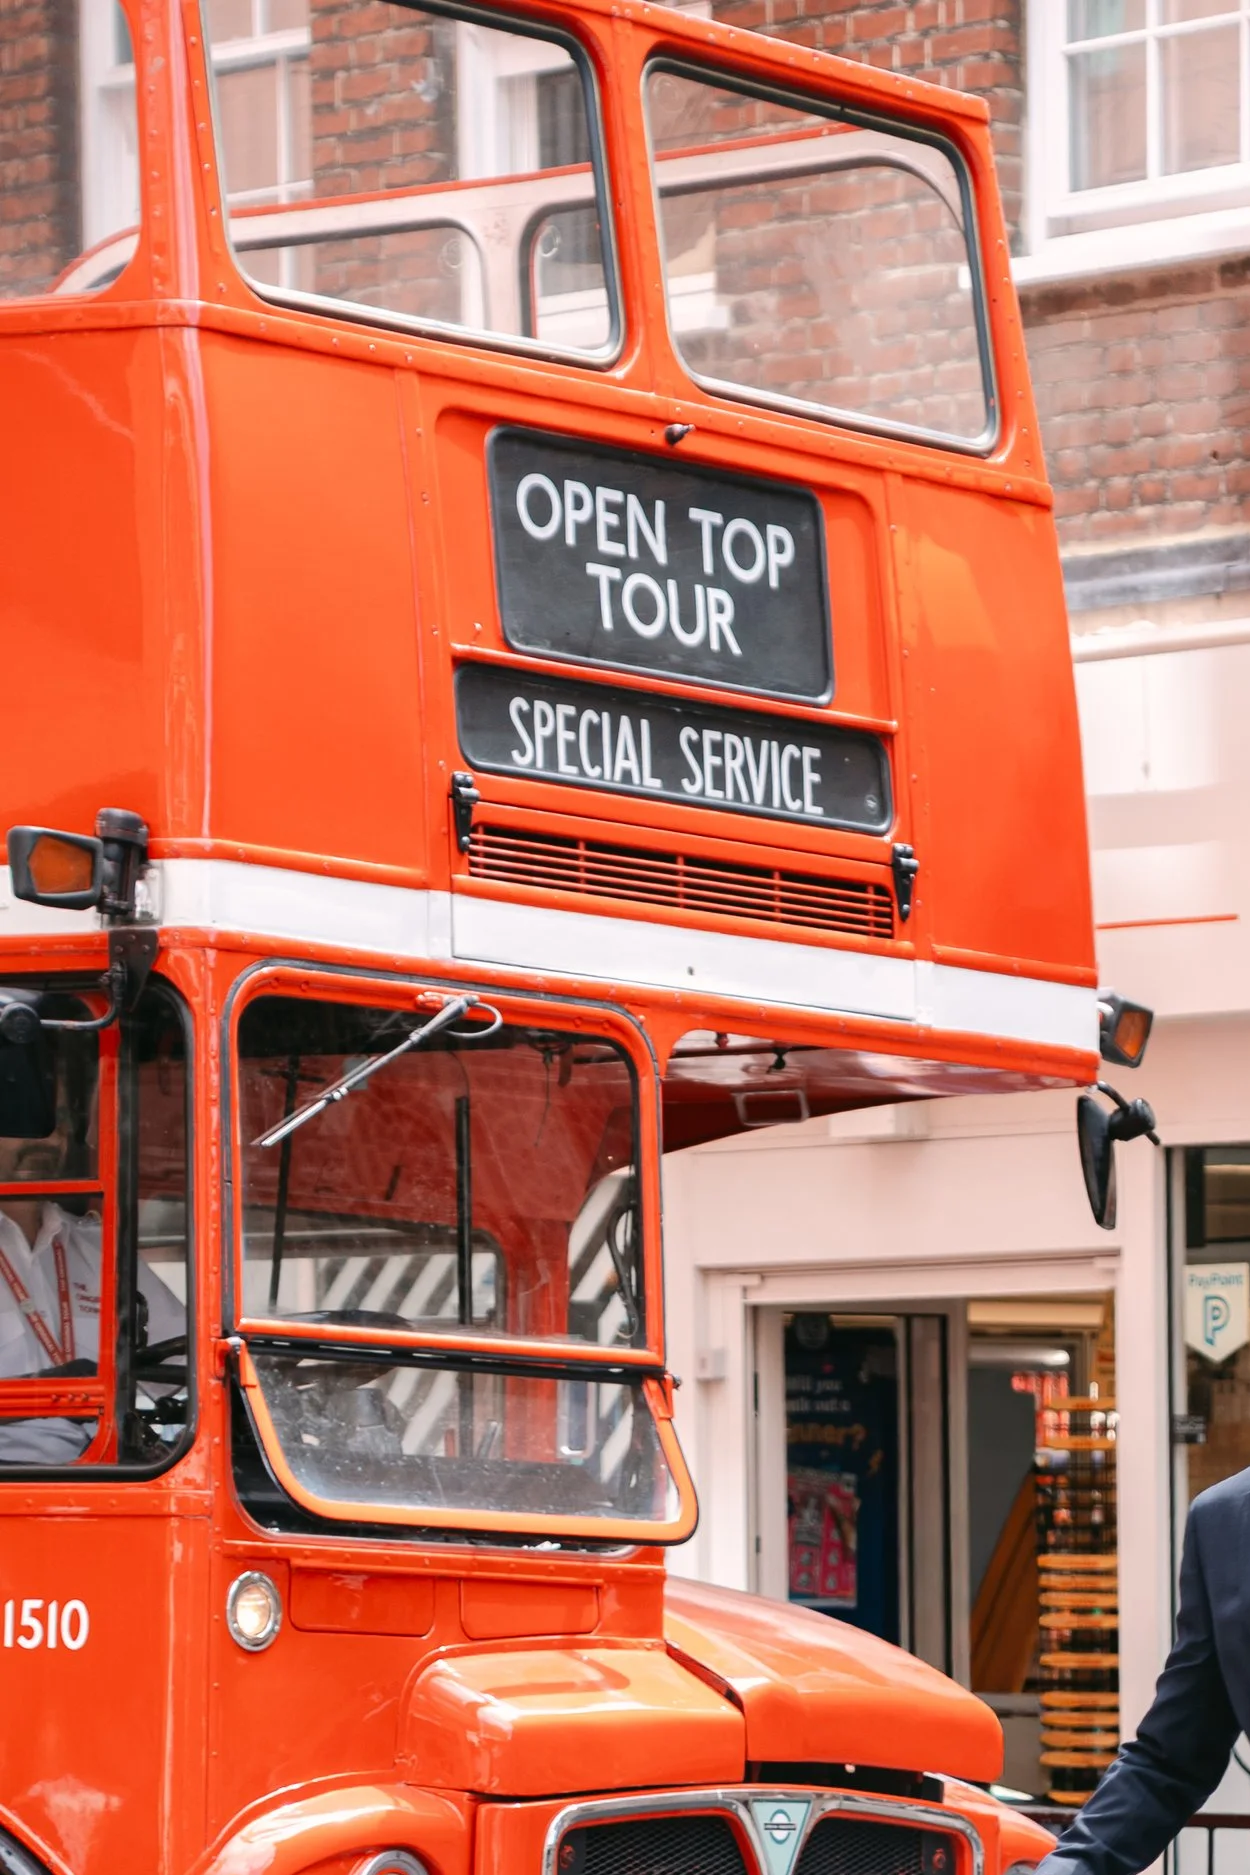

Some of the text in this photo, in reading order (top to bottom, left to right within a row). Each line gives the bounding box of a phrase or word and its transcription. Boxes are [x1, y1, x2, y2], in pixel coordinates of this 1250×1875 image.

[515, 472, 796, 590] OPEN TOP
[585, 562, 743, 656] TOUR
[509, 695, 824, 814] SPECIAL SERVICE
[3, 1599, 90, 1651] 1510
